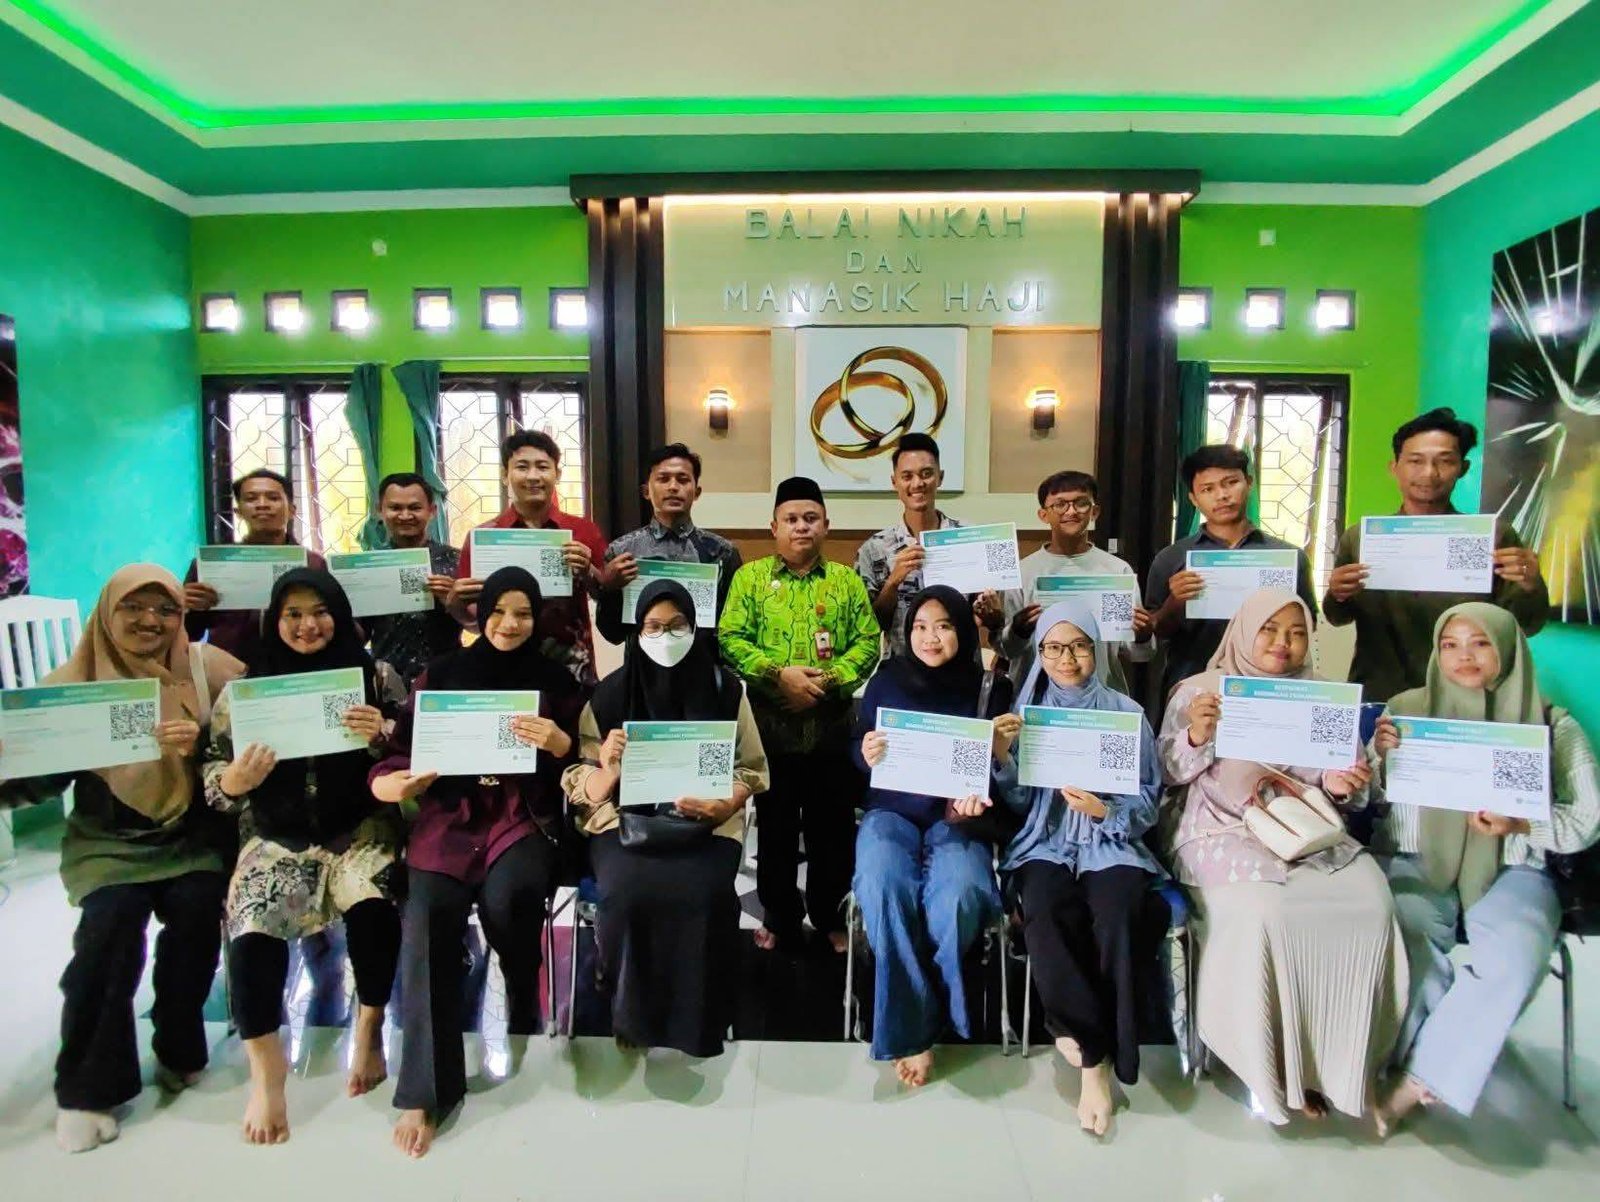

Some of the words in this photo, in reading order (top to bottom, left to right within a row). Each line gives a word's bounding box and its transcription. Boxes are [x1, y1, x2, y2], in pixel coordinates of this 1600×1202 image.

[745, 208, 870, 239] BALAI
[897, 207, 1026, 238] NIKAH
[846, 249, 922, 274] DAN
[723, 281, 921, 313] MANASIK
[944, 281, 1044, 313] HAJI
